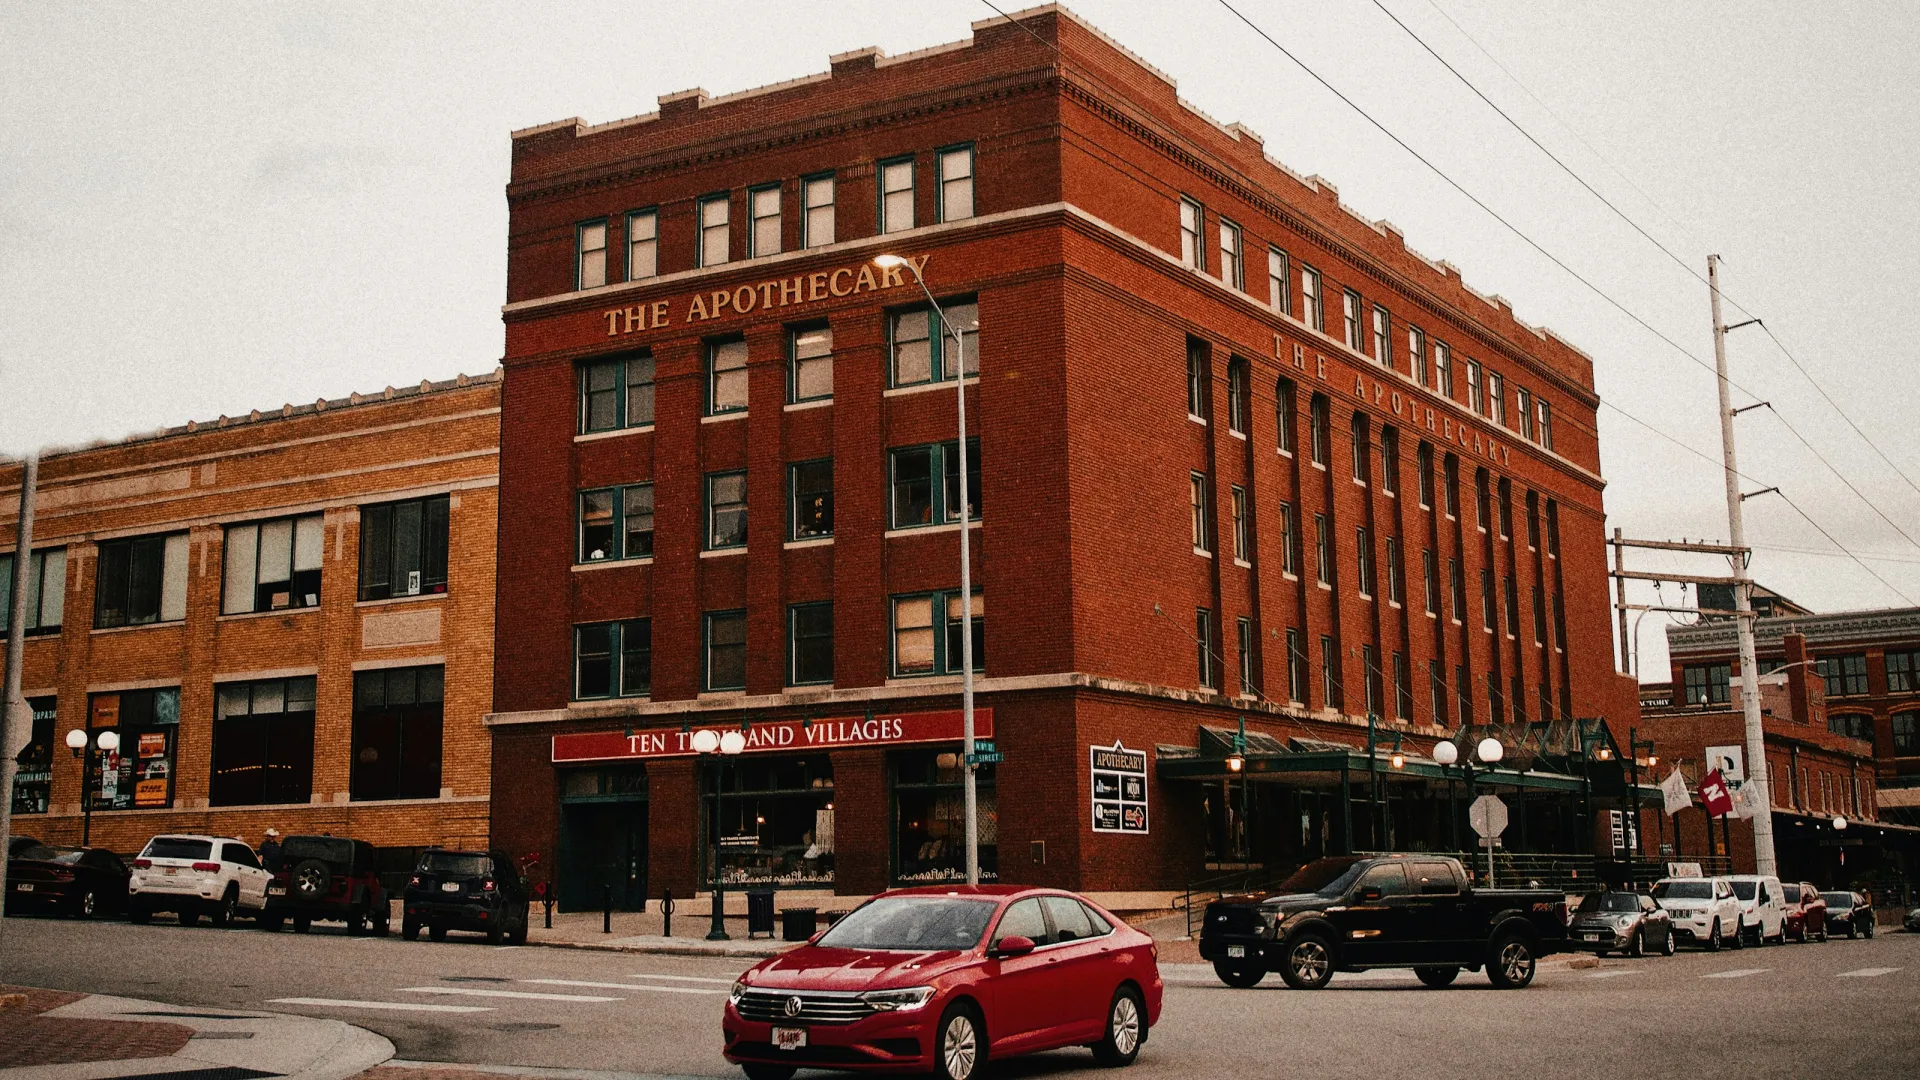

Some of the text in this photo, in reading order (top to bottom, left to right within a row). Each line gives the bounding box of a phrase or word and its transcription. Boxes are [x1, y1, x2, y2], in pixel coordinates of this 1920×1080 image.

[604, 254, 931, 336] THE APOTHECARY
[1273, 333, 1510, 466] THE APOTHECARY
[627, 734, 665, 753] TEN
[804, 718, 903, 744] VILLAGES
[979, 754, 998, 762] STREET
[1097, 752, 1143, 769] APOTHECARY
